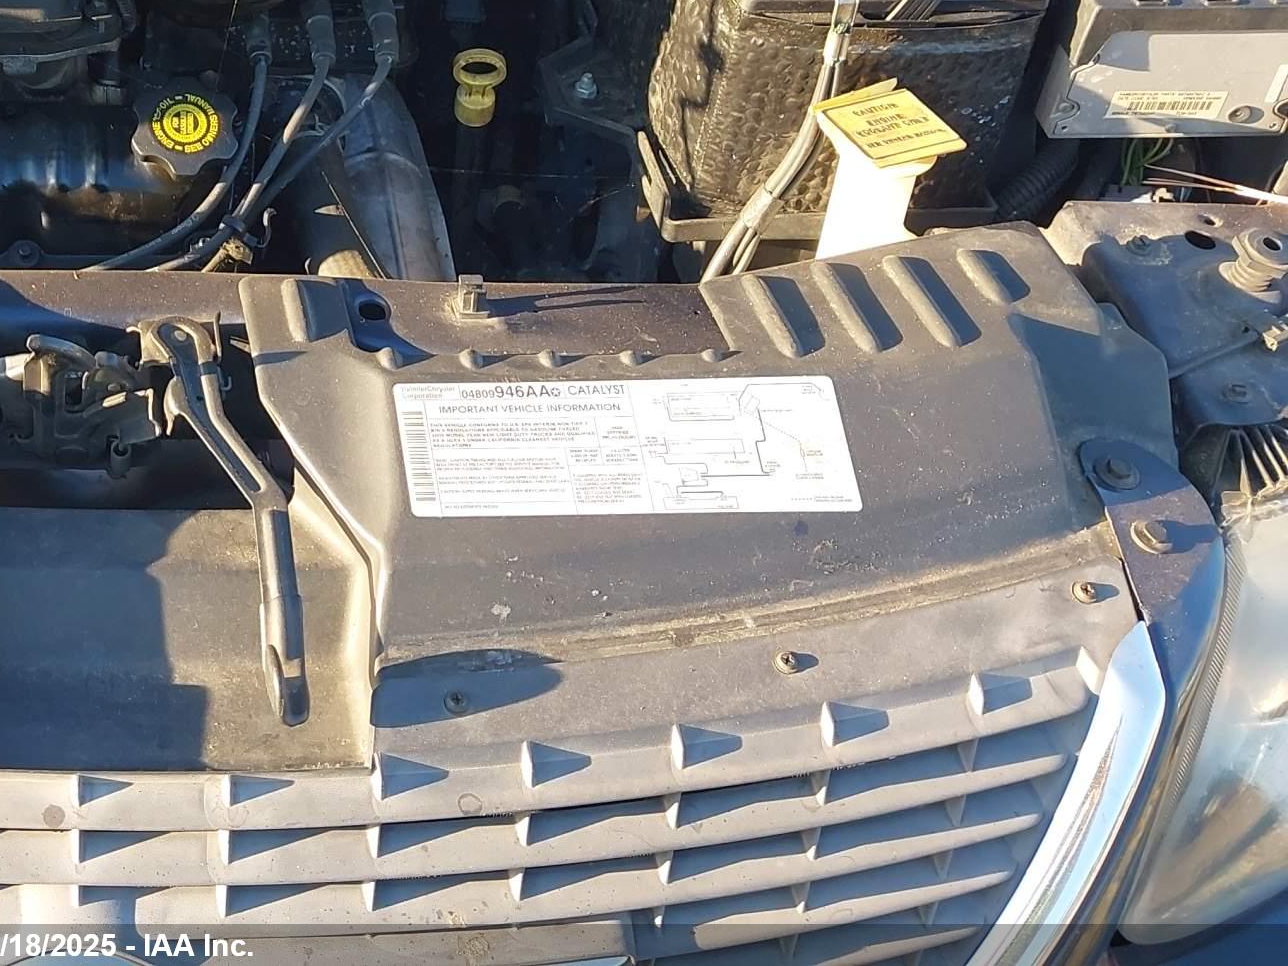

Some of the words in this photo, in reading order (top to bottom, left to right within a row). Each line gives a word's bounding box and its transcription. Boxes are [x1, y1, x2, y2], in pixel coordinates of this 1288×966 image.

[186, 94, 216, 114] MANUAL
[152, 121, 175, 149] ENGINE
[184, 143, 204, 153] SEE
[567, 384, 625, 395] CATALYST
[439, 405, 499, 414] IMPORTANT
[501, 404, 544, 413] VEHICLE
[547, 402, 621, 412] INFORMATION
